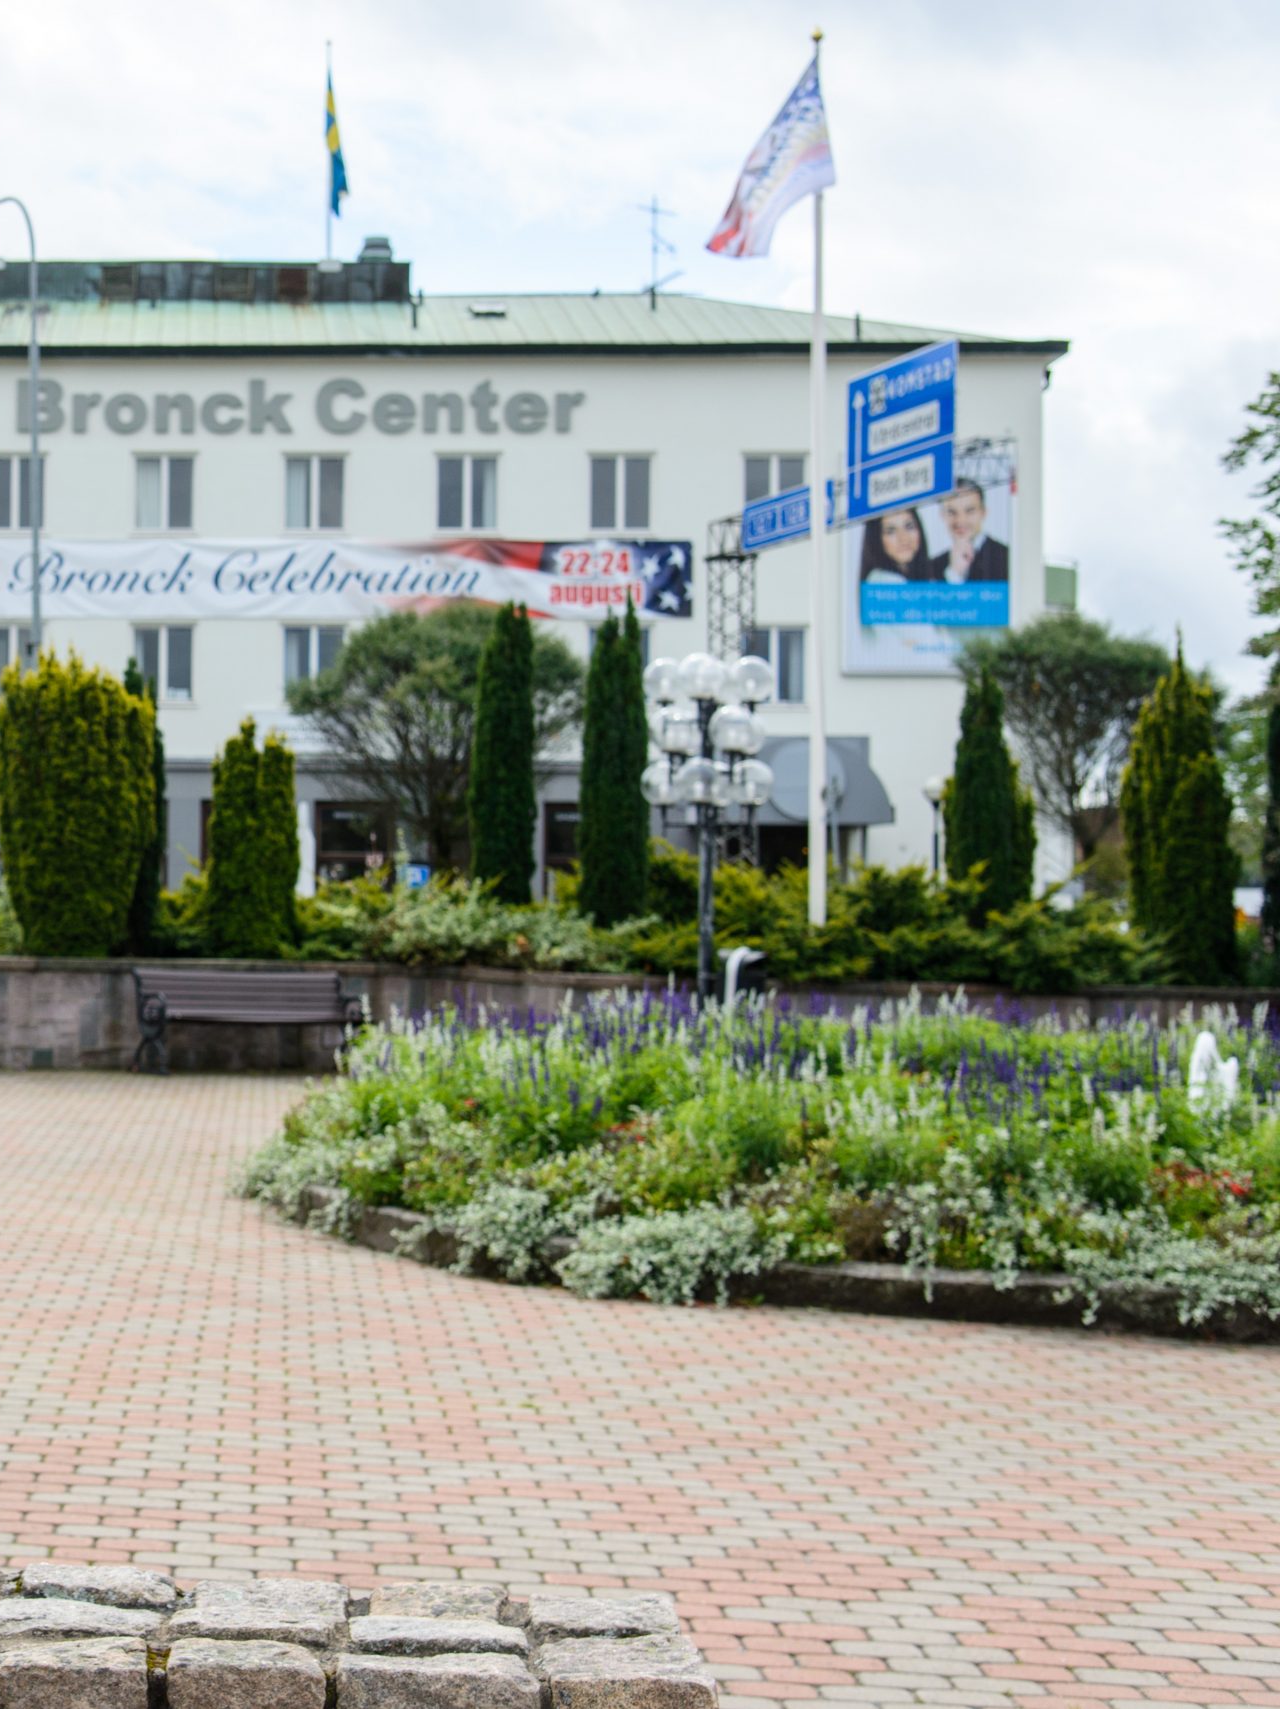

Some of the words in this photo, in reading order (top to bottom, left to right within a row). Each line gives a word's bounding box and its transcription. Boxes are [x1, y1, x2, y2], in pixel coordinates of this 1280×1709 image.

[17, 378, 294, 435] Bronck
[315, 378, 587, 435] Center
[8, 550, 195, 596] Bronck
[213, 550, 481, 598] Celebration
